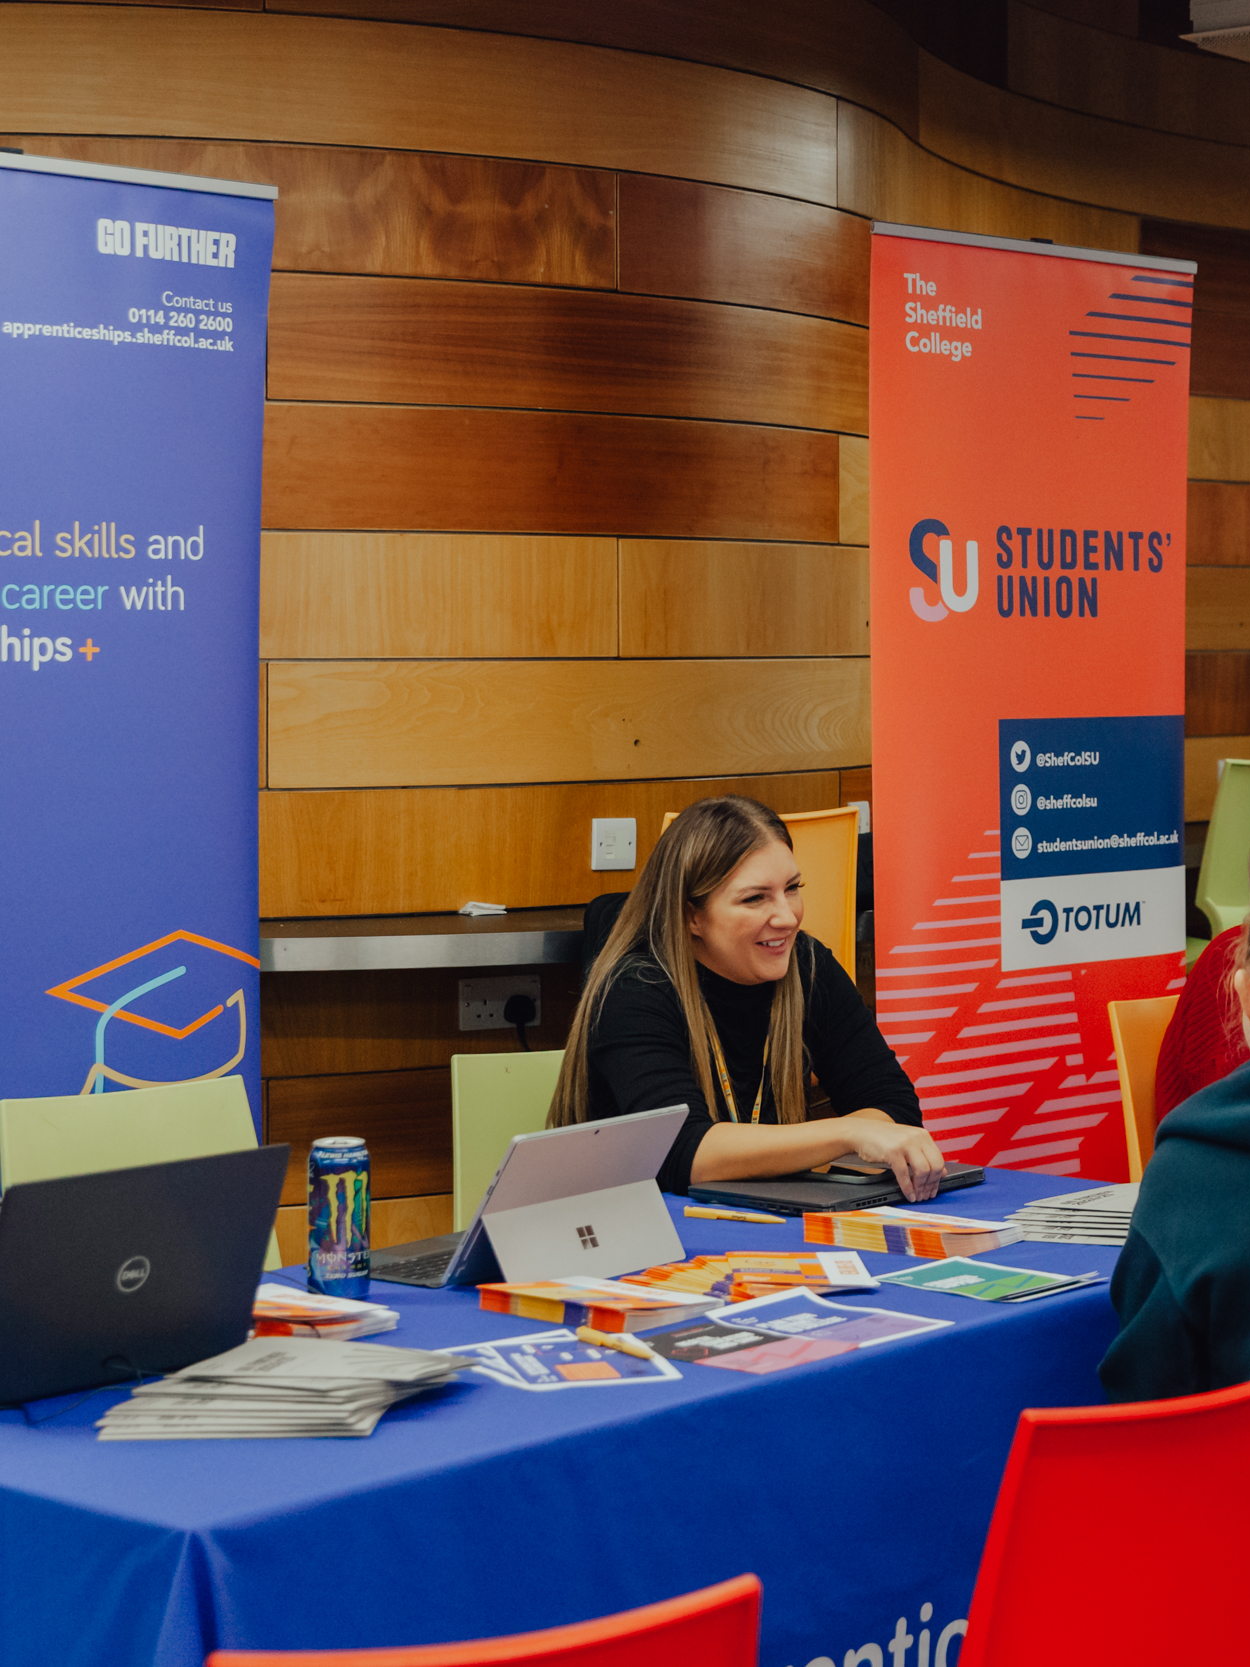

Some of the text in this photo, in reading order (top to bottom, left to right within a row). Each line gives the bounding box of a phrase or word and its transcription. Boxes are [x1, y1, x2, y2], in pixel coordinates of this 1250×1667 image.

[98, 218, 236, 268] GO FURTHER
[904, 272, 937, 296] The
[162, 291, 233, 313] Contact us
[904, 302, 982, 330] Sheffield
[128, 307, 233, 332] 0114 260 2600
[2, 319, 234, 352] apprenticeships.sheffcol.ac.uk
[905, 331, 972, 362] College
[54, 521, 136, 559] skills
[147, 525, 205, 561] and
[1, 574, 185, 611] career with
[996, 574, 1098, 619] UNION
[1036, 751, 1100, 767] @ShefColSU
[1036, 793, 1098, 810] @sheffcolsu
[1037, 830, 1179, 853] studentsunion@sheffcol.ac.uk
[1062, 901, 1141, 933] TOTUM
